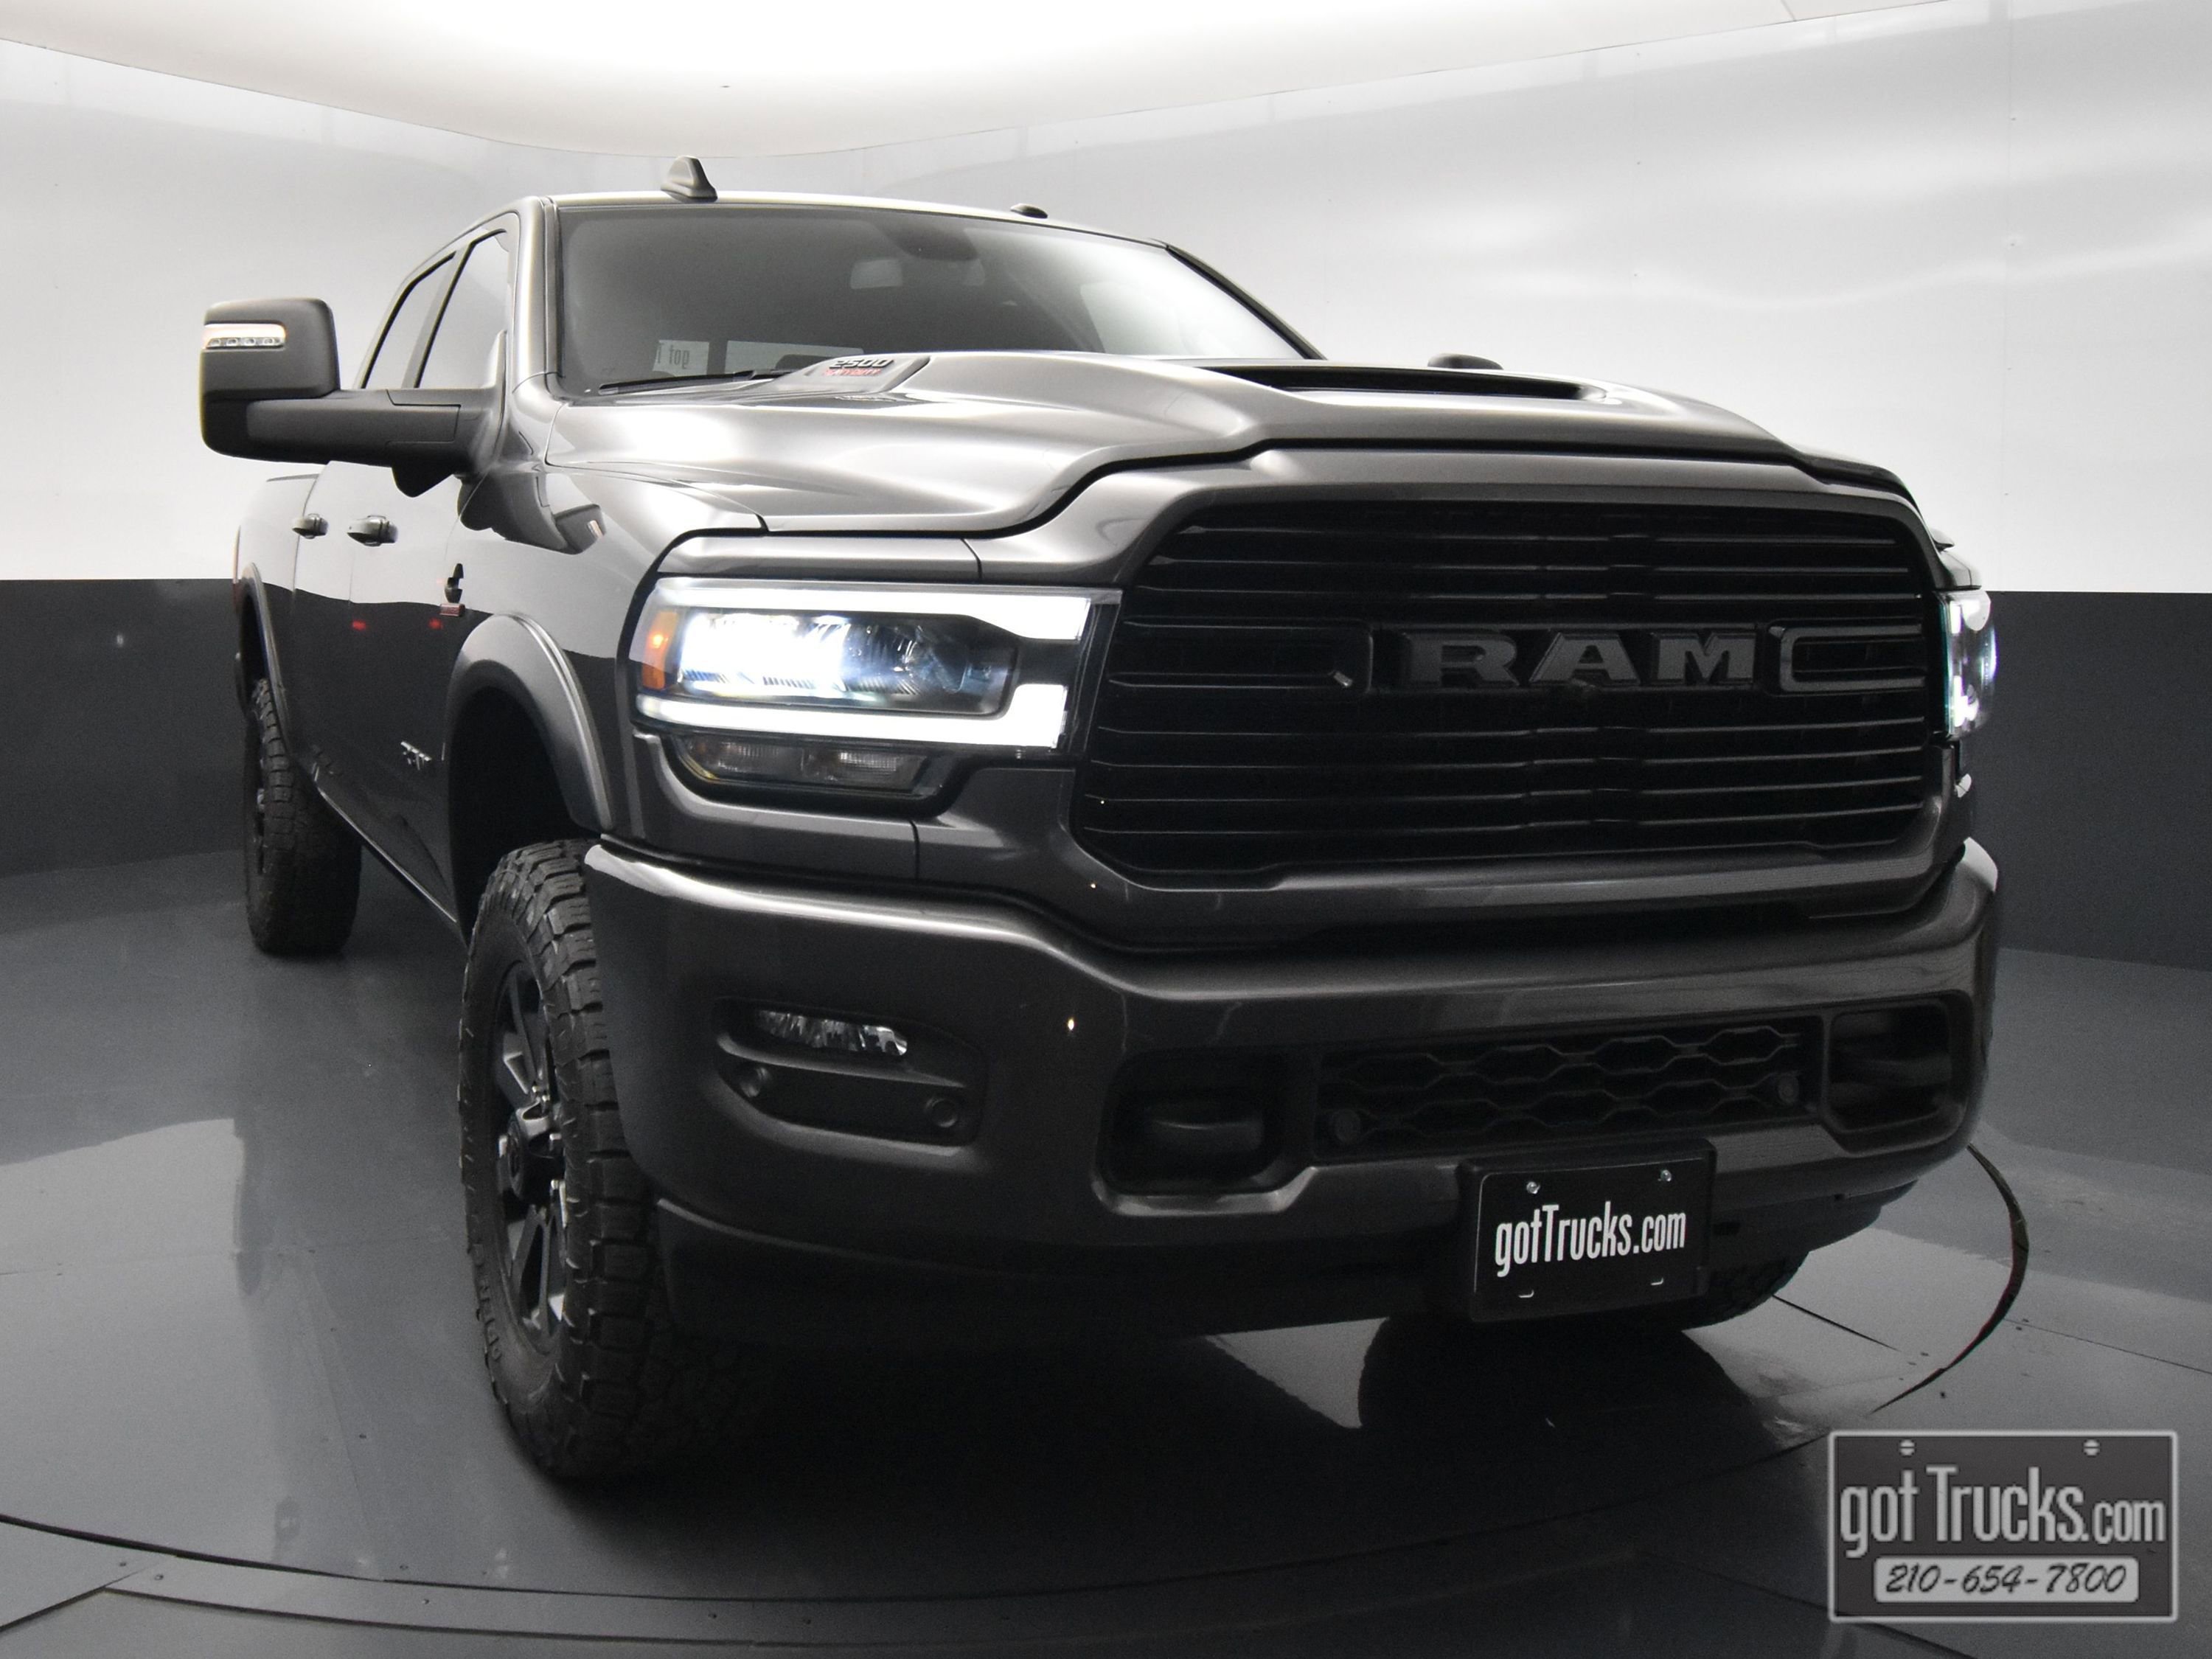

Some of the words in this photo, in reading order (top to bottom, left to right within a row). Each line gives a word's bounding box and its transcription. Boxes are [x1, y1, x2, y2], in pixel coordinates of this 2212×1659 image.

[829, 359, 894, 369] 2500
[1405, 633, 1755, 686] RAM
[1495, 1200, 1686, 1277] gotTrucks.com
